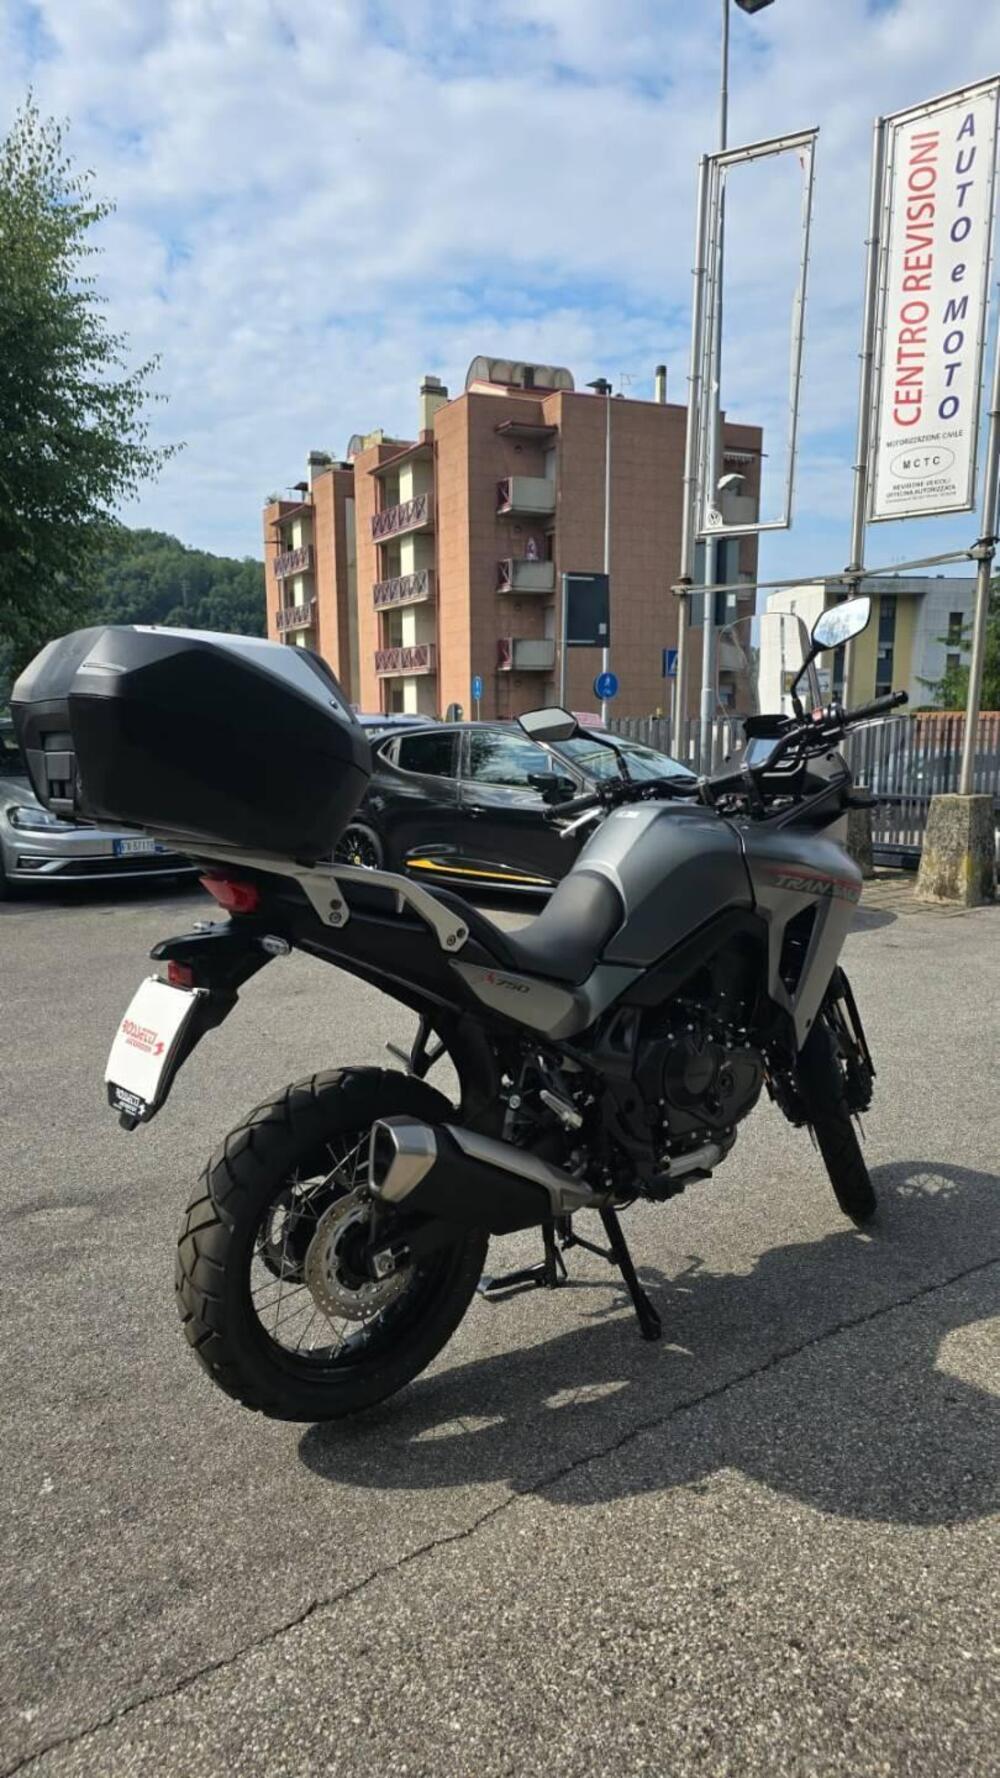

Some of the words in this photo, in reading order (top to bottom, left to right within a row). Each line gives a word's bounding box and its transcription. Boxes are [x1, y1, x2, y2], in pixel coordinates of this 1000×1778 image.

[902, 130, 940, 293] REVISIONI
[949, 112, 976, 243] AUTO
[892, 300, 930, 427] CENTRO
[938, 297, 968, 419] MOTO
[886, 434, 939, 447] MOTORIZZAZIONE
[942, 430, 963, 439] CIVILE
